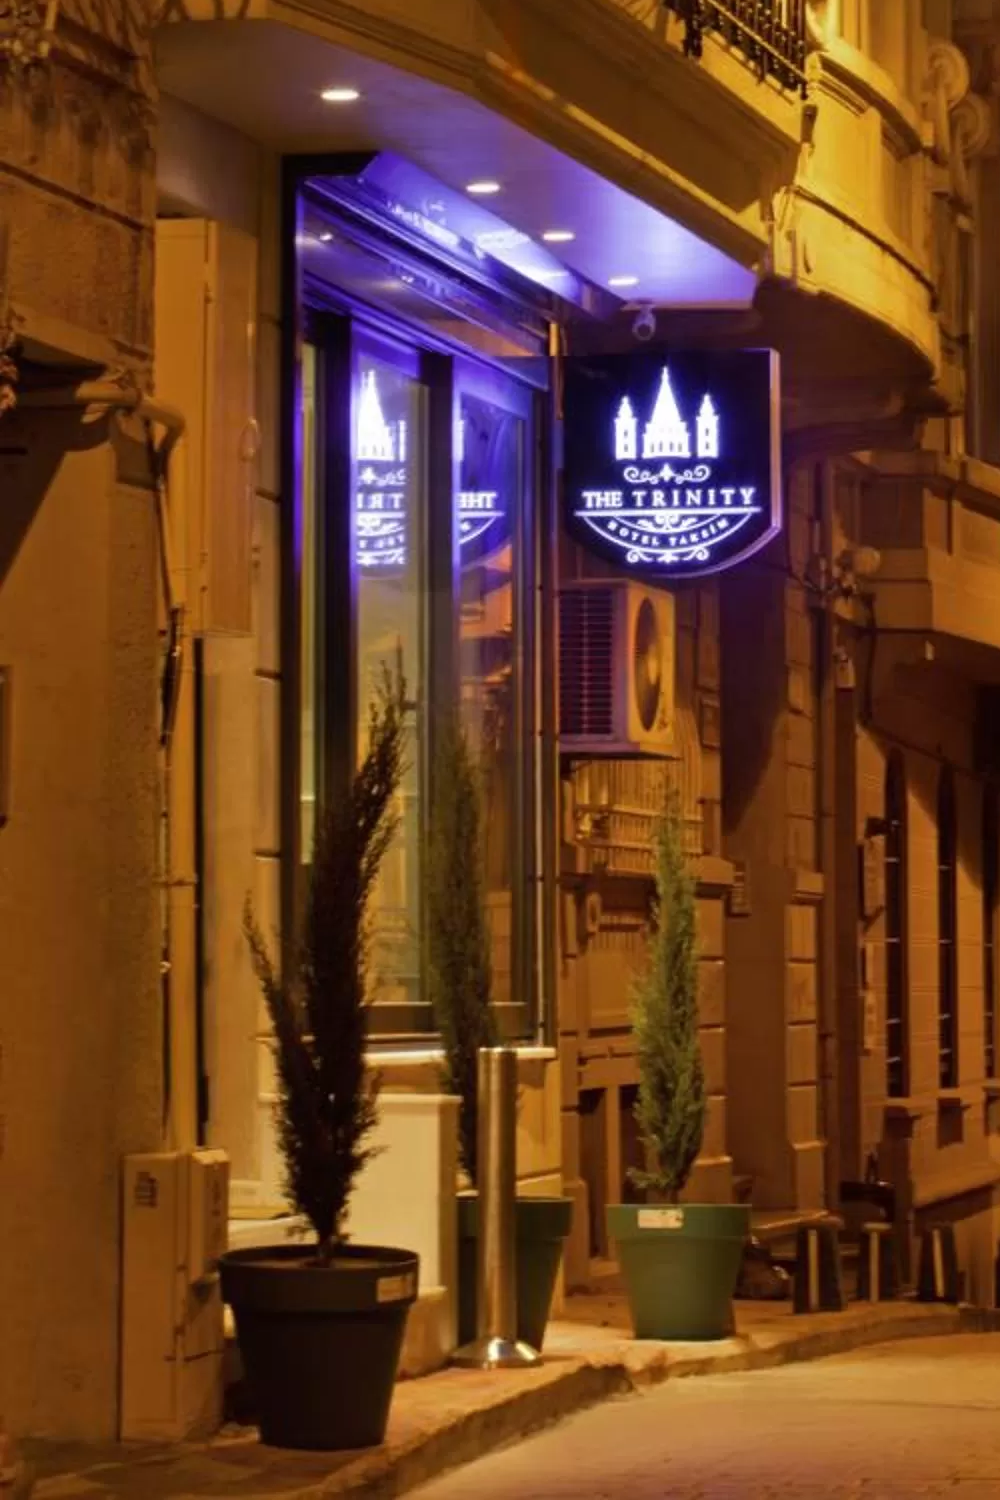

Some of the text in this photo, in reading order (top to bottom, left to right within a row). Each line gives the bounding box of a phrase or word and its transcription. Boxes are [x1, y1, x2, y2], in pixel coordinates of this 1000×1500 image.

[581, 487, 756, 508] THE TRINITY
[607, 520, 660, 546] HOTEL
